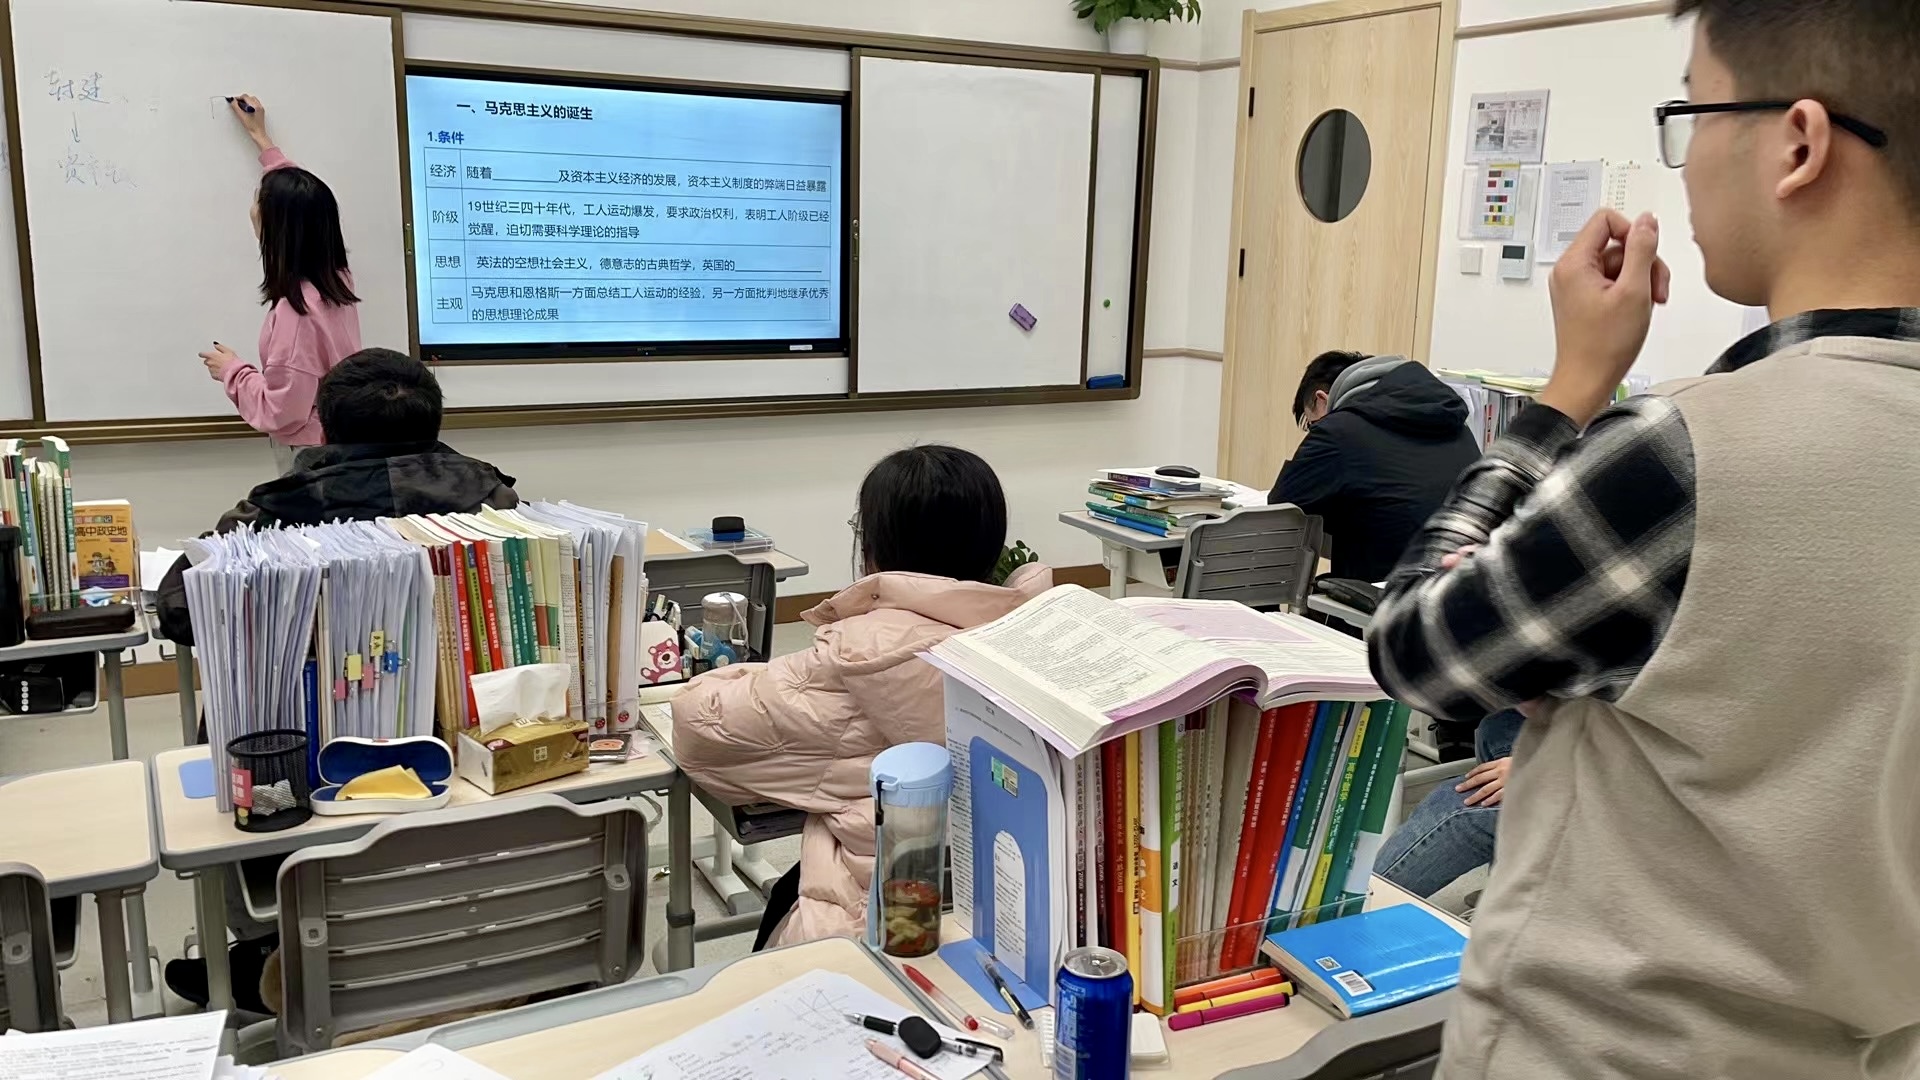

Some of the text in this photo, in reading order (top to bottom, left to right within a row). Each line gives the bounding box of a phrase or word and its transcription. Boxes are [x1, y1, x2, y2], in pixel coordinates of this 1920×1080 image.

[456, 100, 594, 121] 一、马克思主义的诞生
[427, 130, 465, 145] 1.条件
[429, 164, 457, 179] 经济
[466, 165, 493, 180] 随着
[431, 210, 459, 224] 阶级
[467, 223, 640, 239] 觉醒，迫切需要科学理论的指导
[434, 255, 462, 268] 思想
[436, 297, 464, 310] 主观
[471, 307, 560, 321] 的思想理论成果
